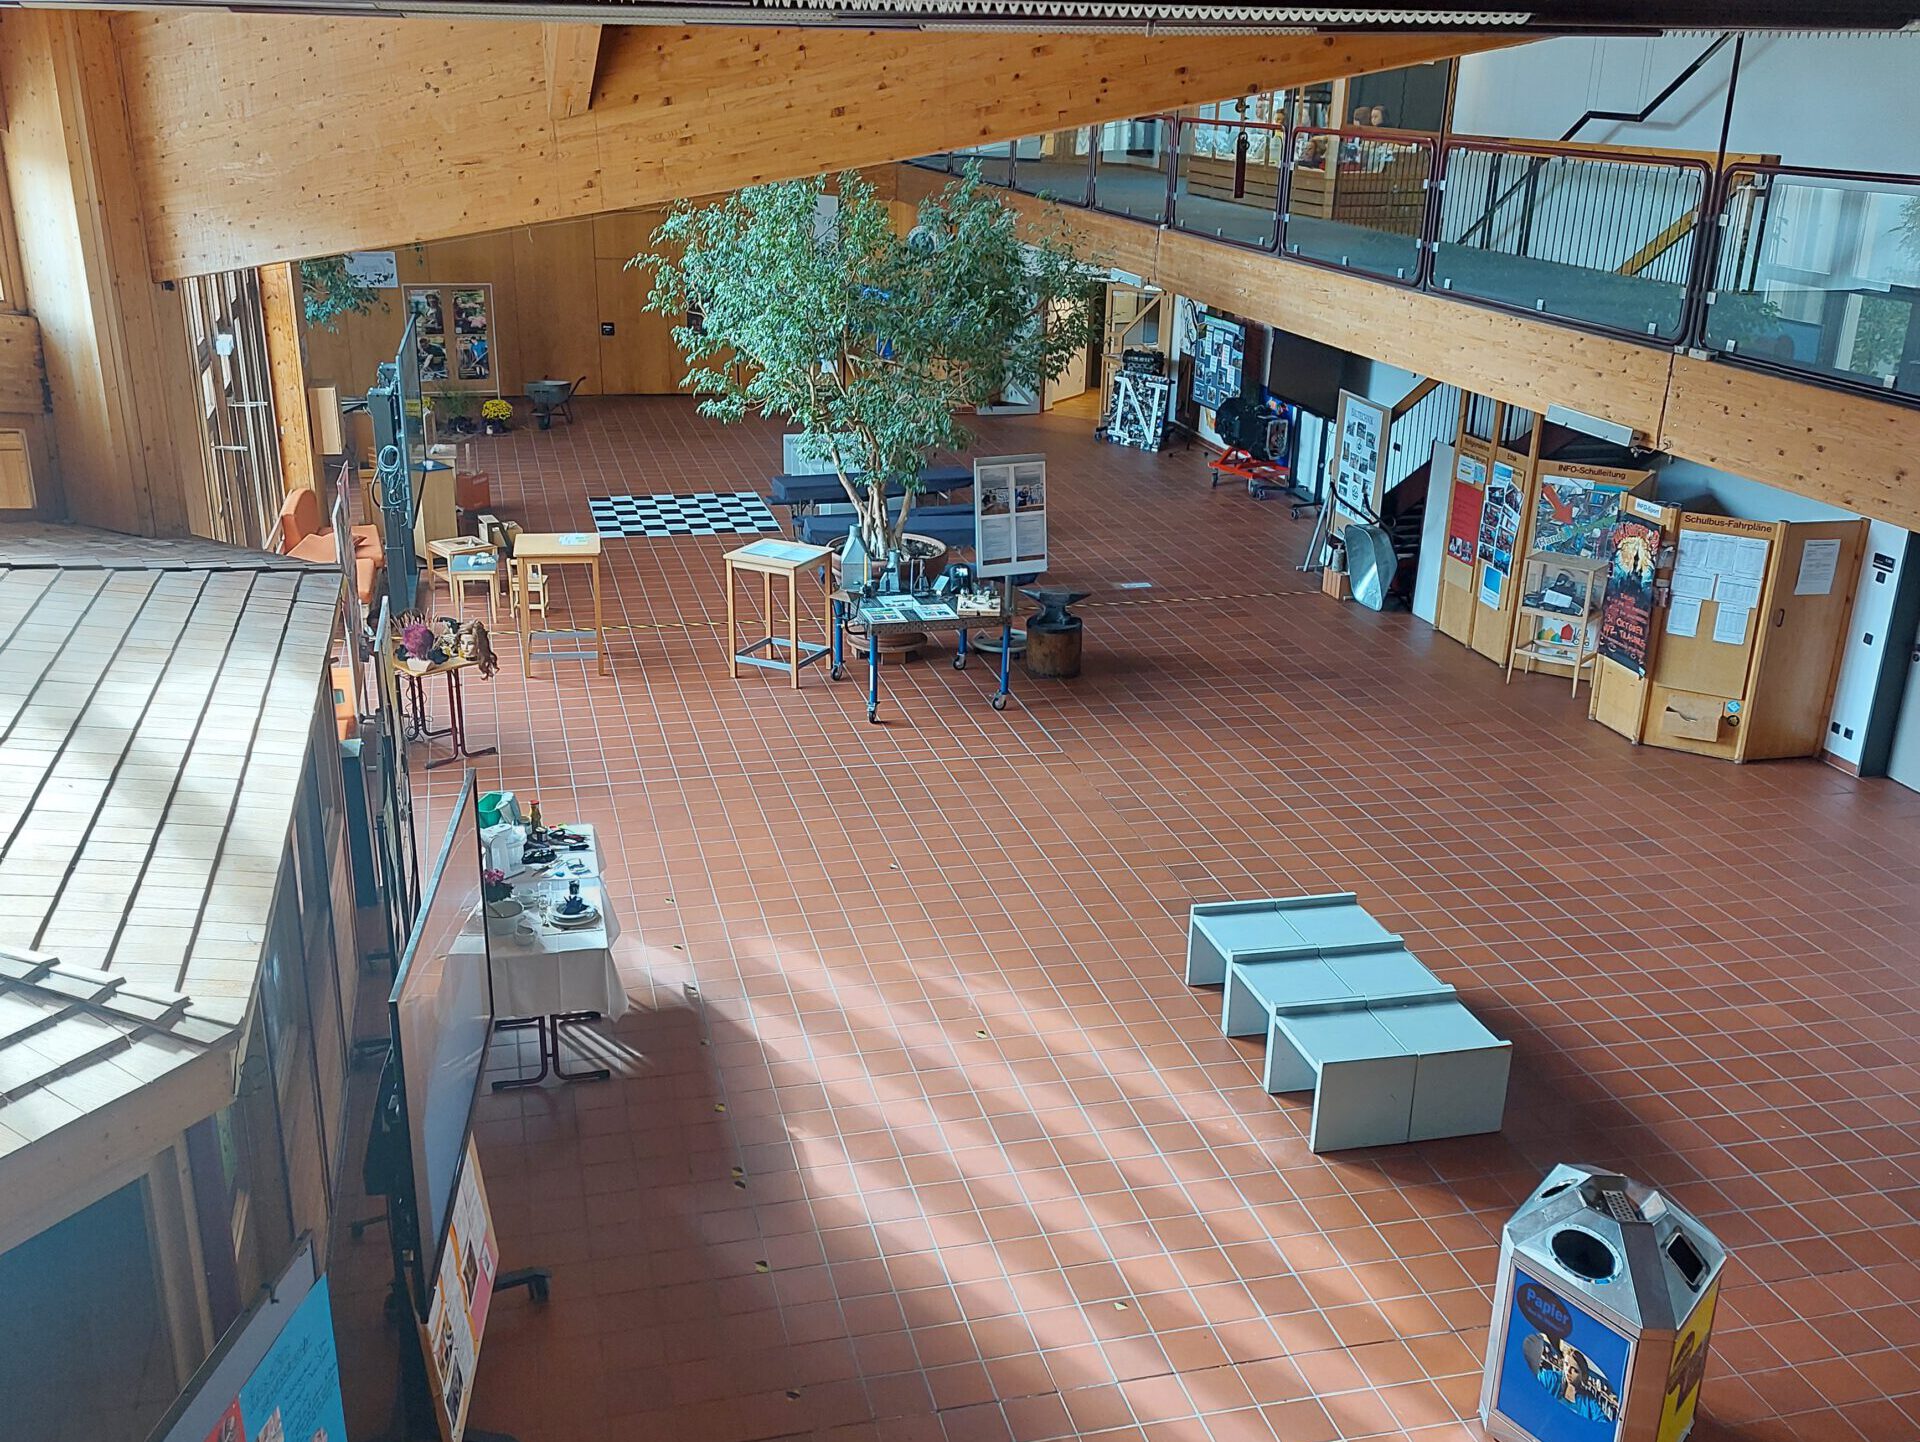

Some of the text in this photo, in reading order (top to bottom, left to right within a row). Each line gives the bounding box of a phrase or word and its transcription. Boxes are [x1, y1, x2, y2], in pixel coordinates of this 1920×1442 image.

[1558, 464, 1626, 480] INFO-Schulleitung
[1684, 514, 1772, 533] Schulbus-Fahrpläne
[1526, 1287, 1570, 1325] Papier
